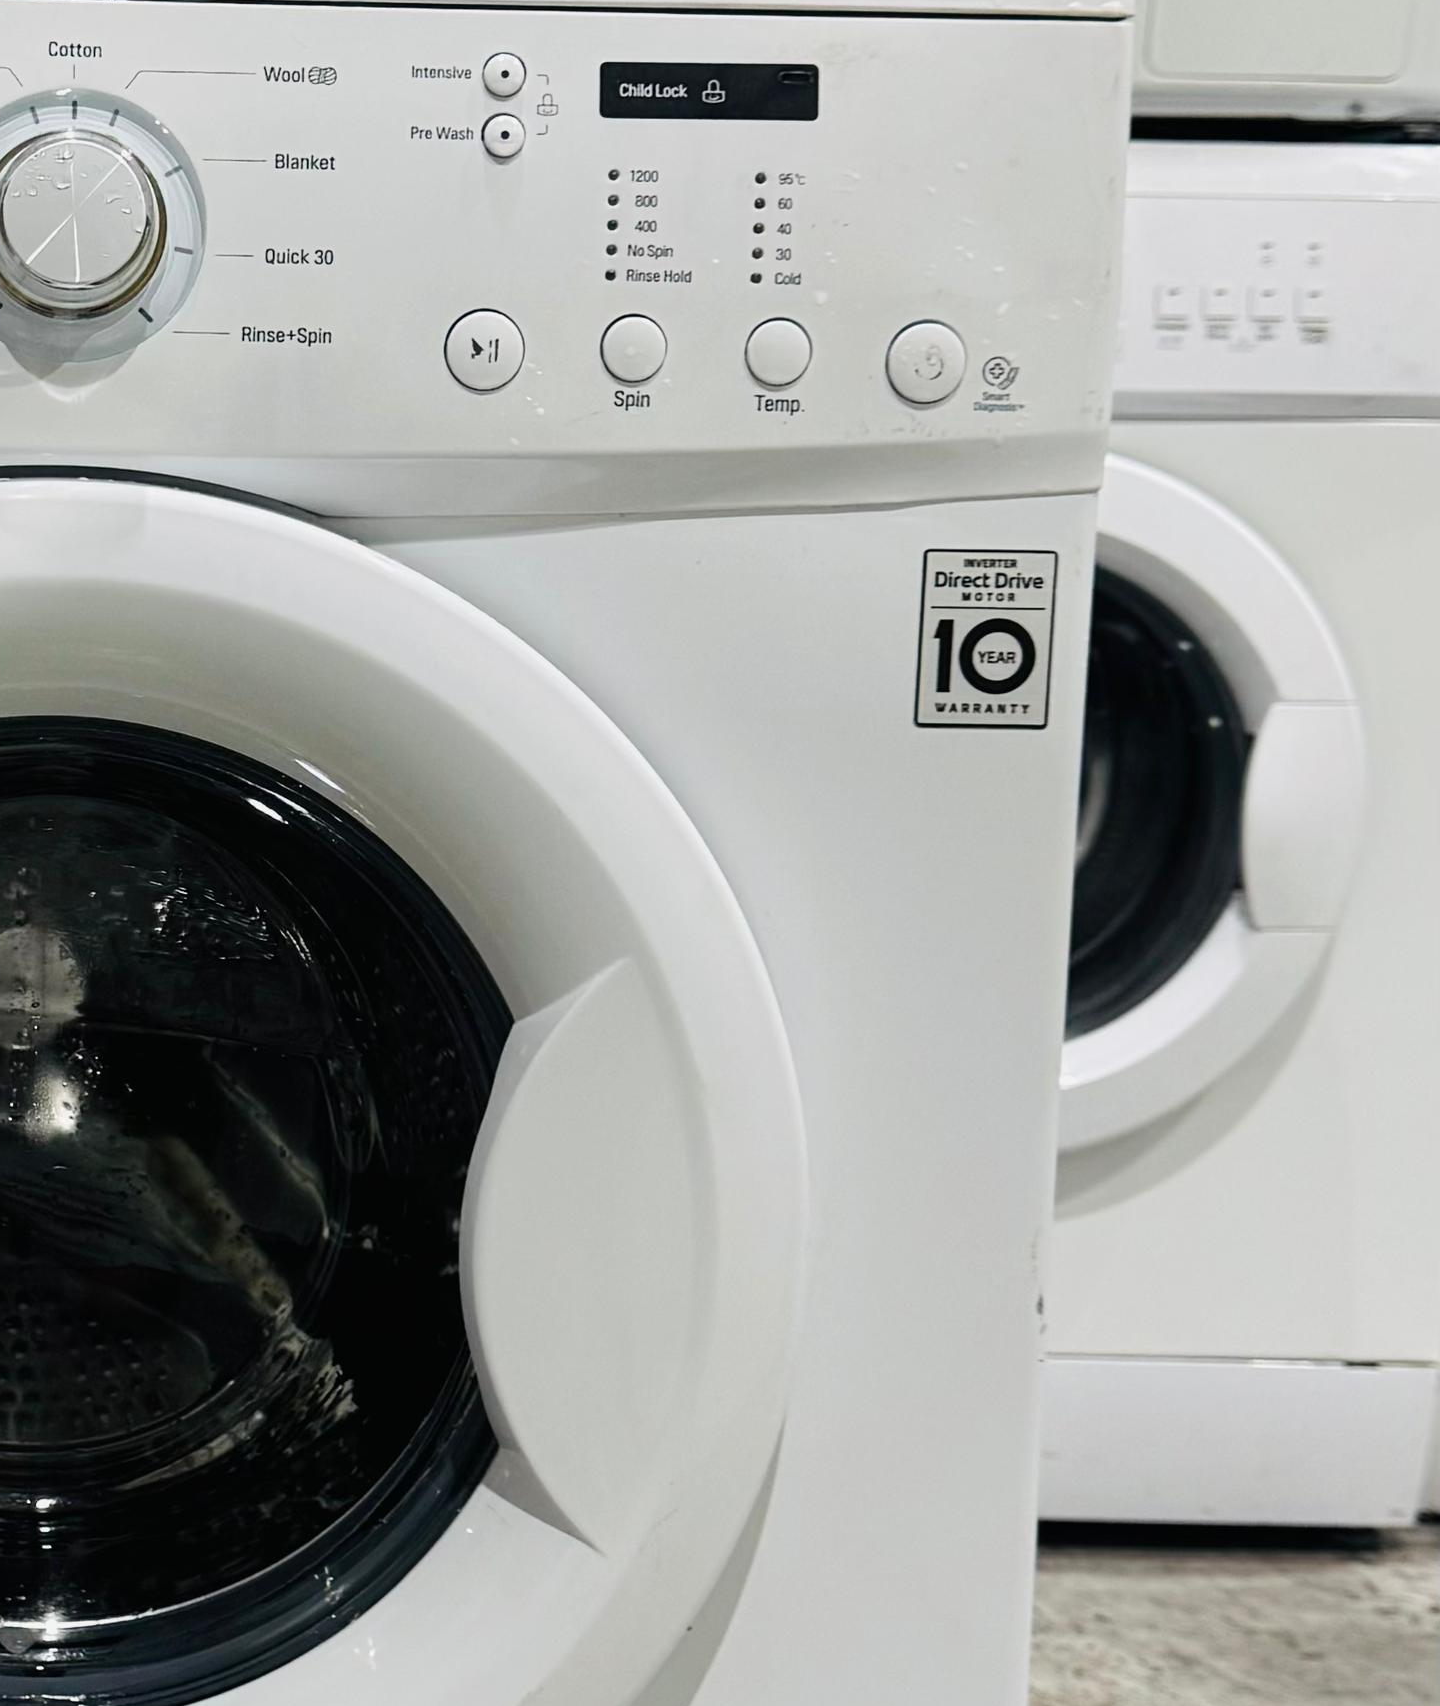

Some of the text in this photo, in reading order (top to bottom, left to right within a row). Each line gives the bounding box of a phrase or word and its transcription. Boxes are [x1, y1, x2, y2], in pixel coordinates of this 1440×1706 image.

[47, 40, 103, 60] Cotton
[263, 65, 306, 84] Wool
[410, 65, 472, 81] Intensive
[619, 82, 688, 100] Child Lock
[410, 125, 475, 141] Pre Wash
[274, 153, 336, 171] Blanket
[630, 170, 659, 183] 1200
[634, 195, 658, 208] 800
[777, 197, 793, 210] 60
[634, 220, 657, 233] 400
[776, 222, 792, 235] 40
[264, 248, 335, 267] Quick 30
[627, 244, 674, 260] No Spin
[775, 247, 792, 261] 30
[626, 269, 693, 283] Rinse Hold
[774, 272, 802, 285] Cold
[241, 326, 333, 347] Rinse+Spin
[613, 391, 651, 412] Spin
[753, 394, 806, 417] Temp.
[964, 558, 1018, 569] INVERTER
[934, 571, 1045, 589] Direct Drive
[961, 592, 1016, 602] MOTOR
[933, 617, 1037, 695] 10
[978, 650, 1016, 664] YEAR
[934, 702, 1031, 714] WARRANTY
